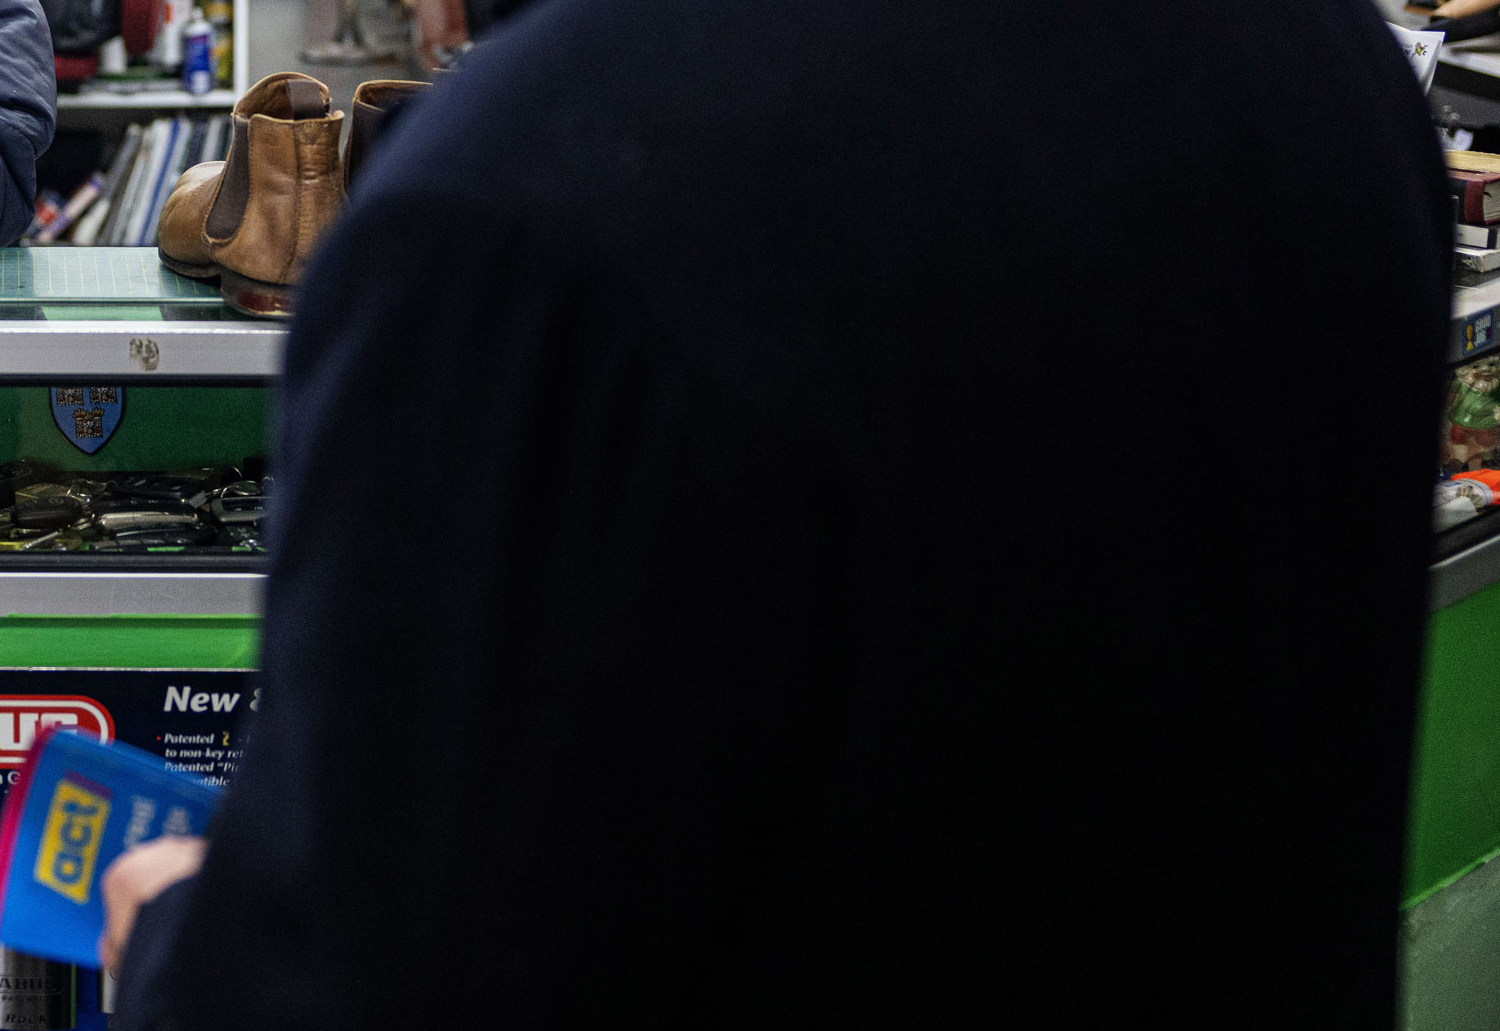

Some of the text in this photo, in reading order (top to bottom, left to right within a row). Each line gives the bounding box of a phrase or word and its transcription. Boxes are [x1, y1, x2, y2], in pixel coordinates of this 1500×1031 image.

[164, 686, 240, 712] New
[164, 733, 215, 744] Patented
[165, 748, 178, 758] to
[179, 747, 225, 761] non-key
[165, 762, 215, 773] Patented
[52, 800, 98, 884] act
